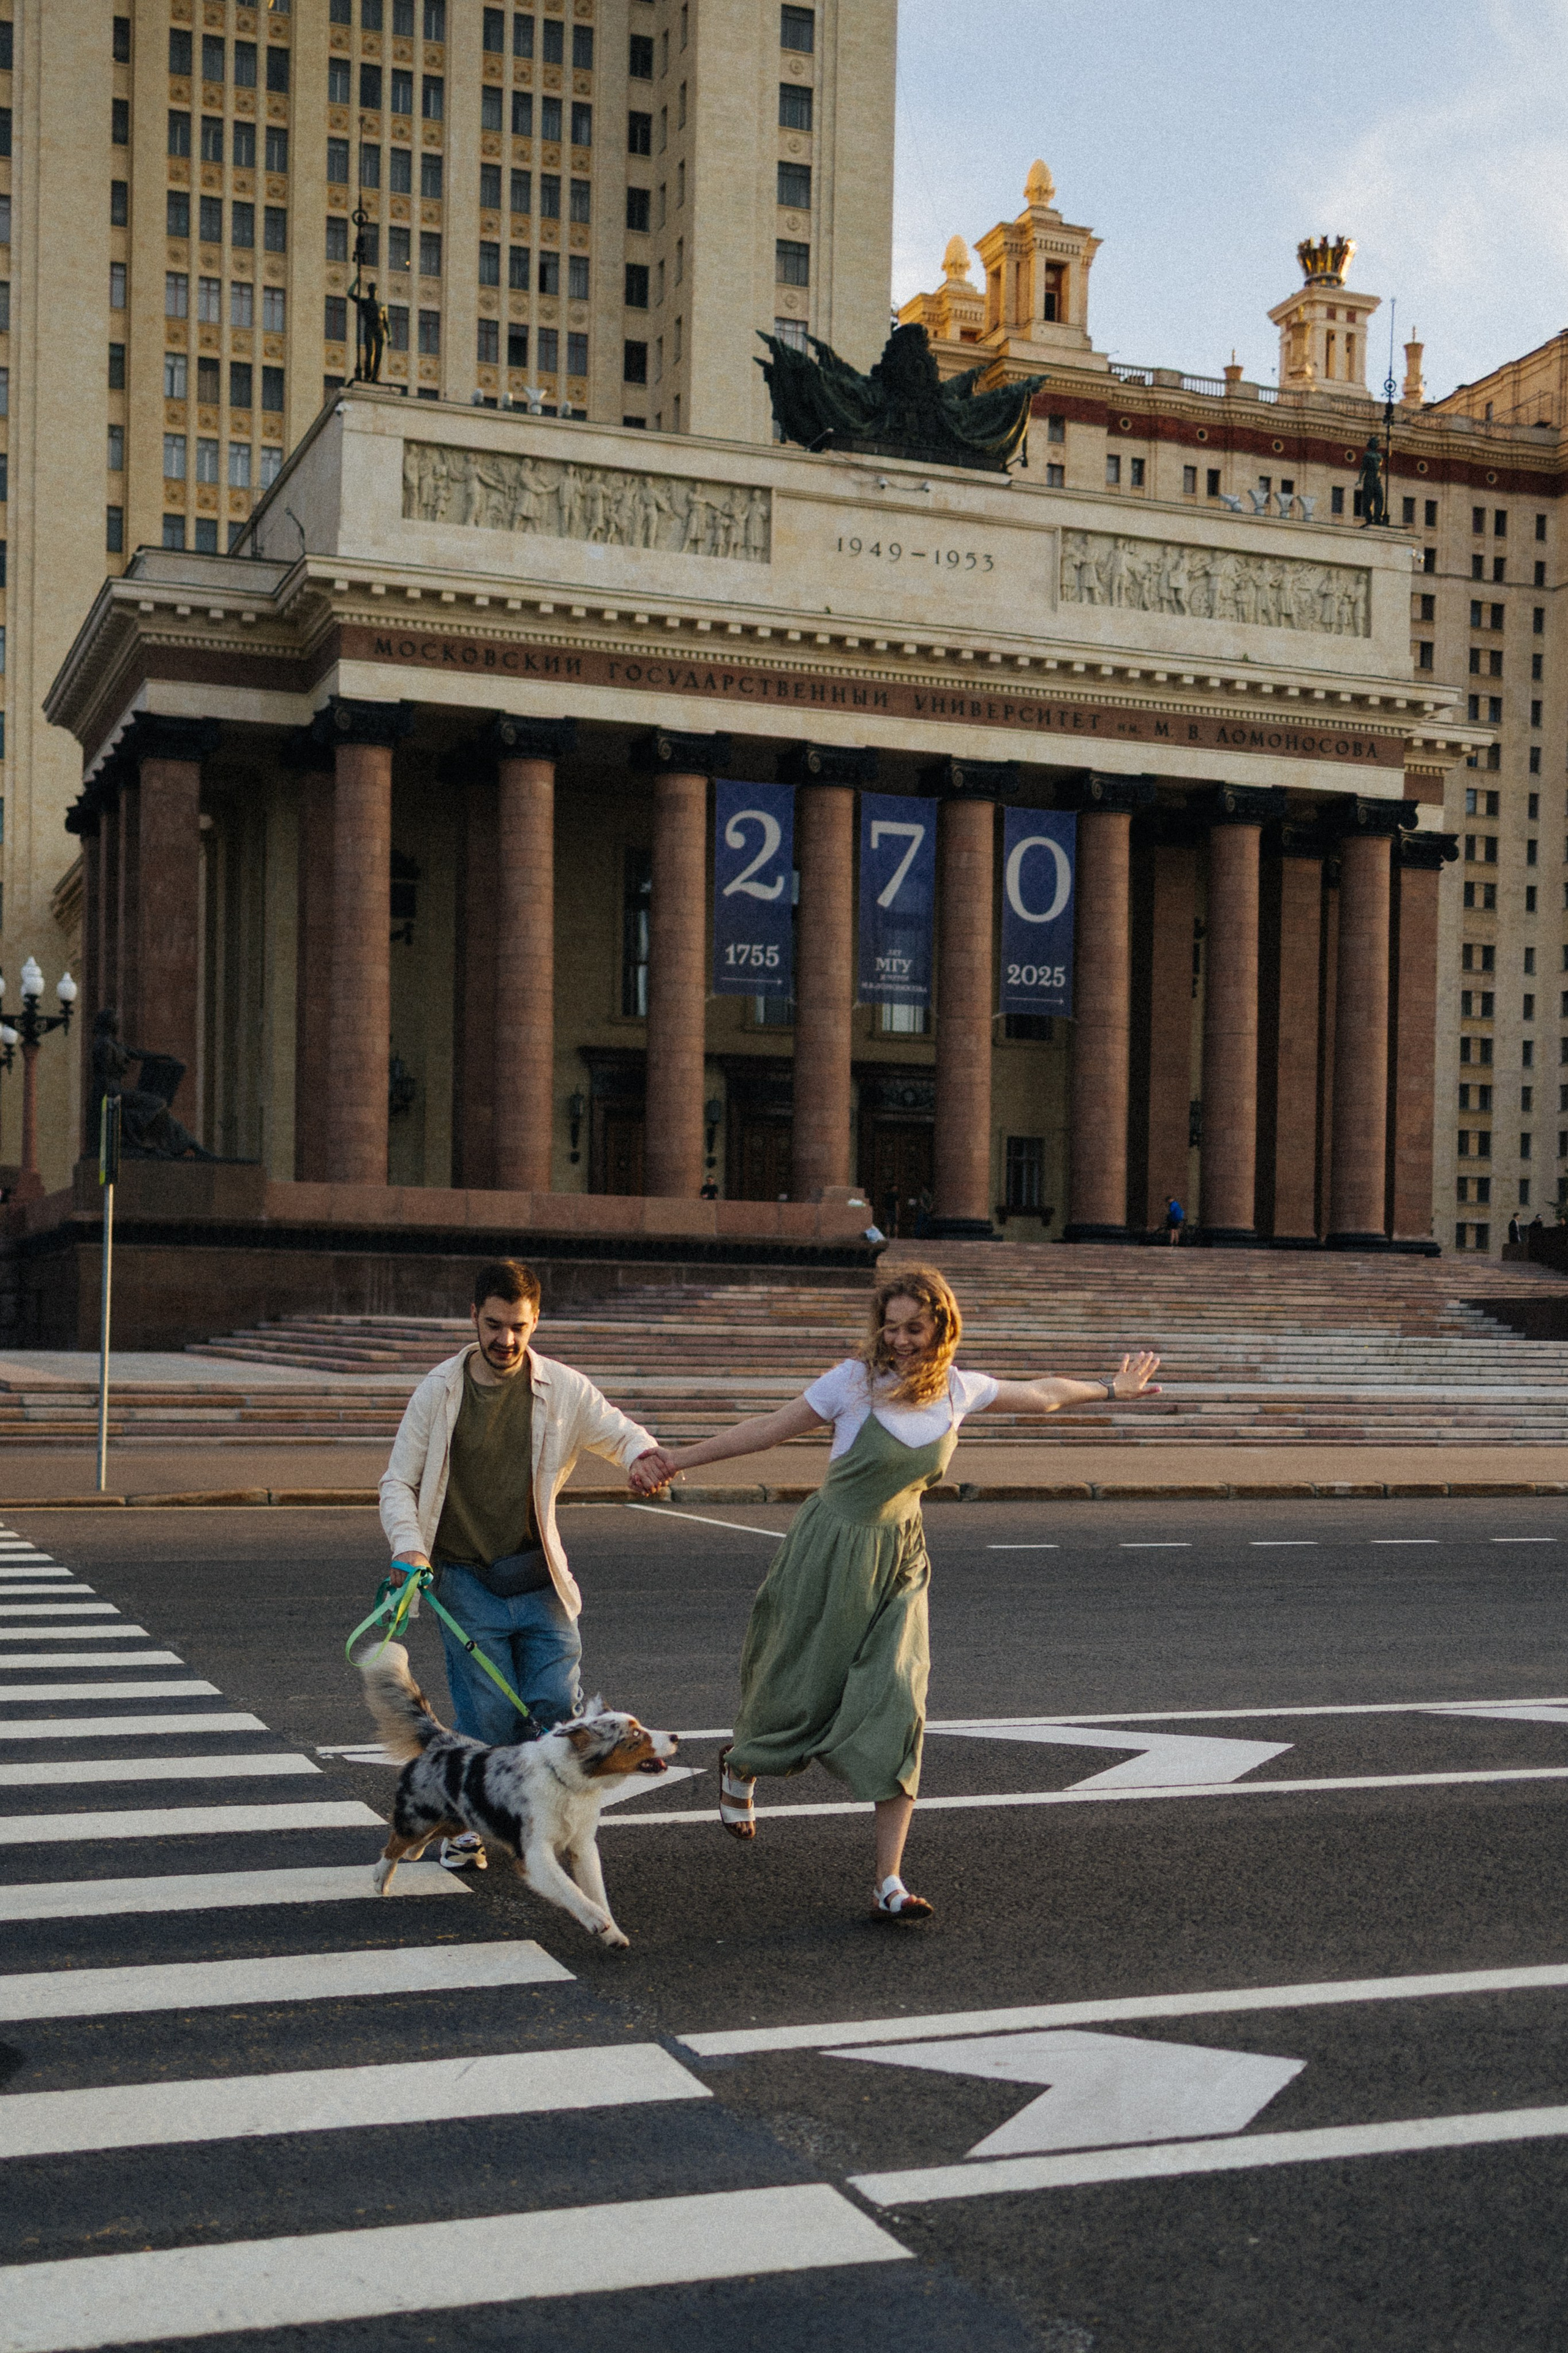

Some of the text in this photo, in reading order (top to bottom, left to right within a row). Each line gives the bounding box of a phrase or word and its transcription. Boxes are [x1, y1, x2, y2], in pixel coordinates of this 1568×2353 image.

[914, 694, 1101, 730] УНИВЕРСИТЕТ
[1216, 728, 1378, 758] ЛОМОНОСОВА
[723, 810, 785, 900] 2
[871, 820, 925, 908] 7
[1006, 836, 1071, 923] 0
[725, 943, 780, 967] 1755
[875, 957, 913, 973] МГУ
[1007, 964, 1066, 988] 2025
